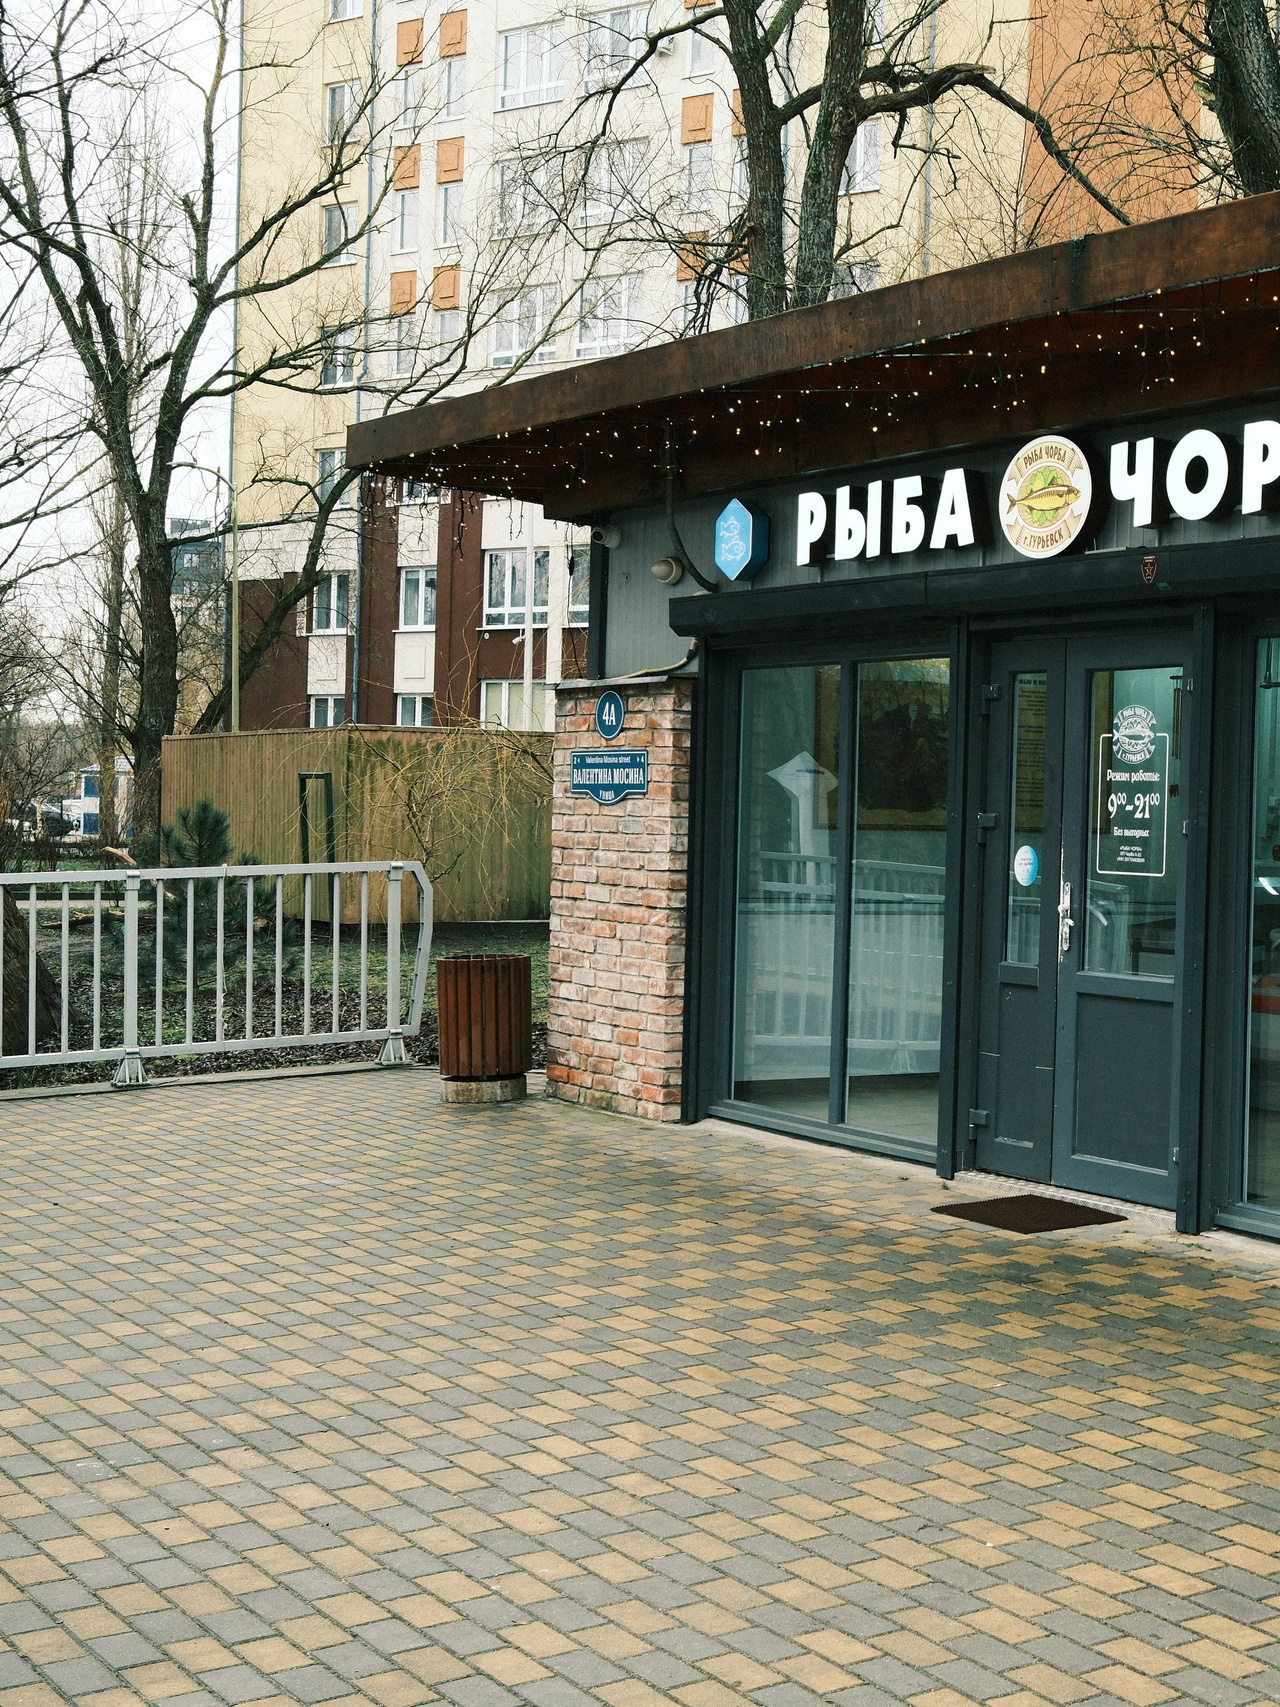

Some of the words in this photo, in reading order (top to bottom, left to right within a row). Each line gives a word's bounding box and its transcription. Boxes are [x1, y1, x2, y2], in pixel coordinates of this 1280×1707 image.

[1023, 447, 1043, 469] РЫБА
[1044, 445, 1067, 463] ЧОРБА
[797, 468, 975, 566] РЫБА
[602, 702, 616, 725] 4А
[573, 768, 612, 784] ВАЛЕНТИНА
[613, 768, 644, 784] МОСИНА
[1107, 769, 1130, 781] Режим
[1131, 769, 1160, 783] работы:
[599, 790, 615, 800] УЛИЦА
[1113, 826, 1123, 836] Без
